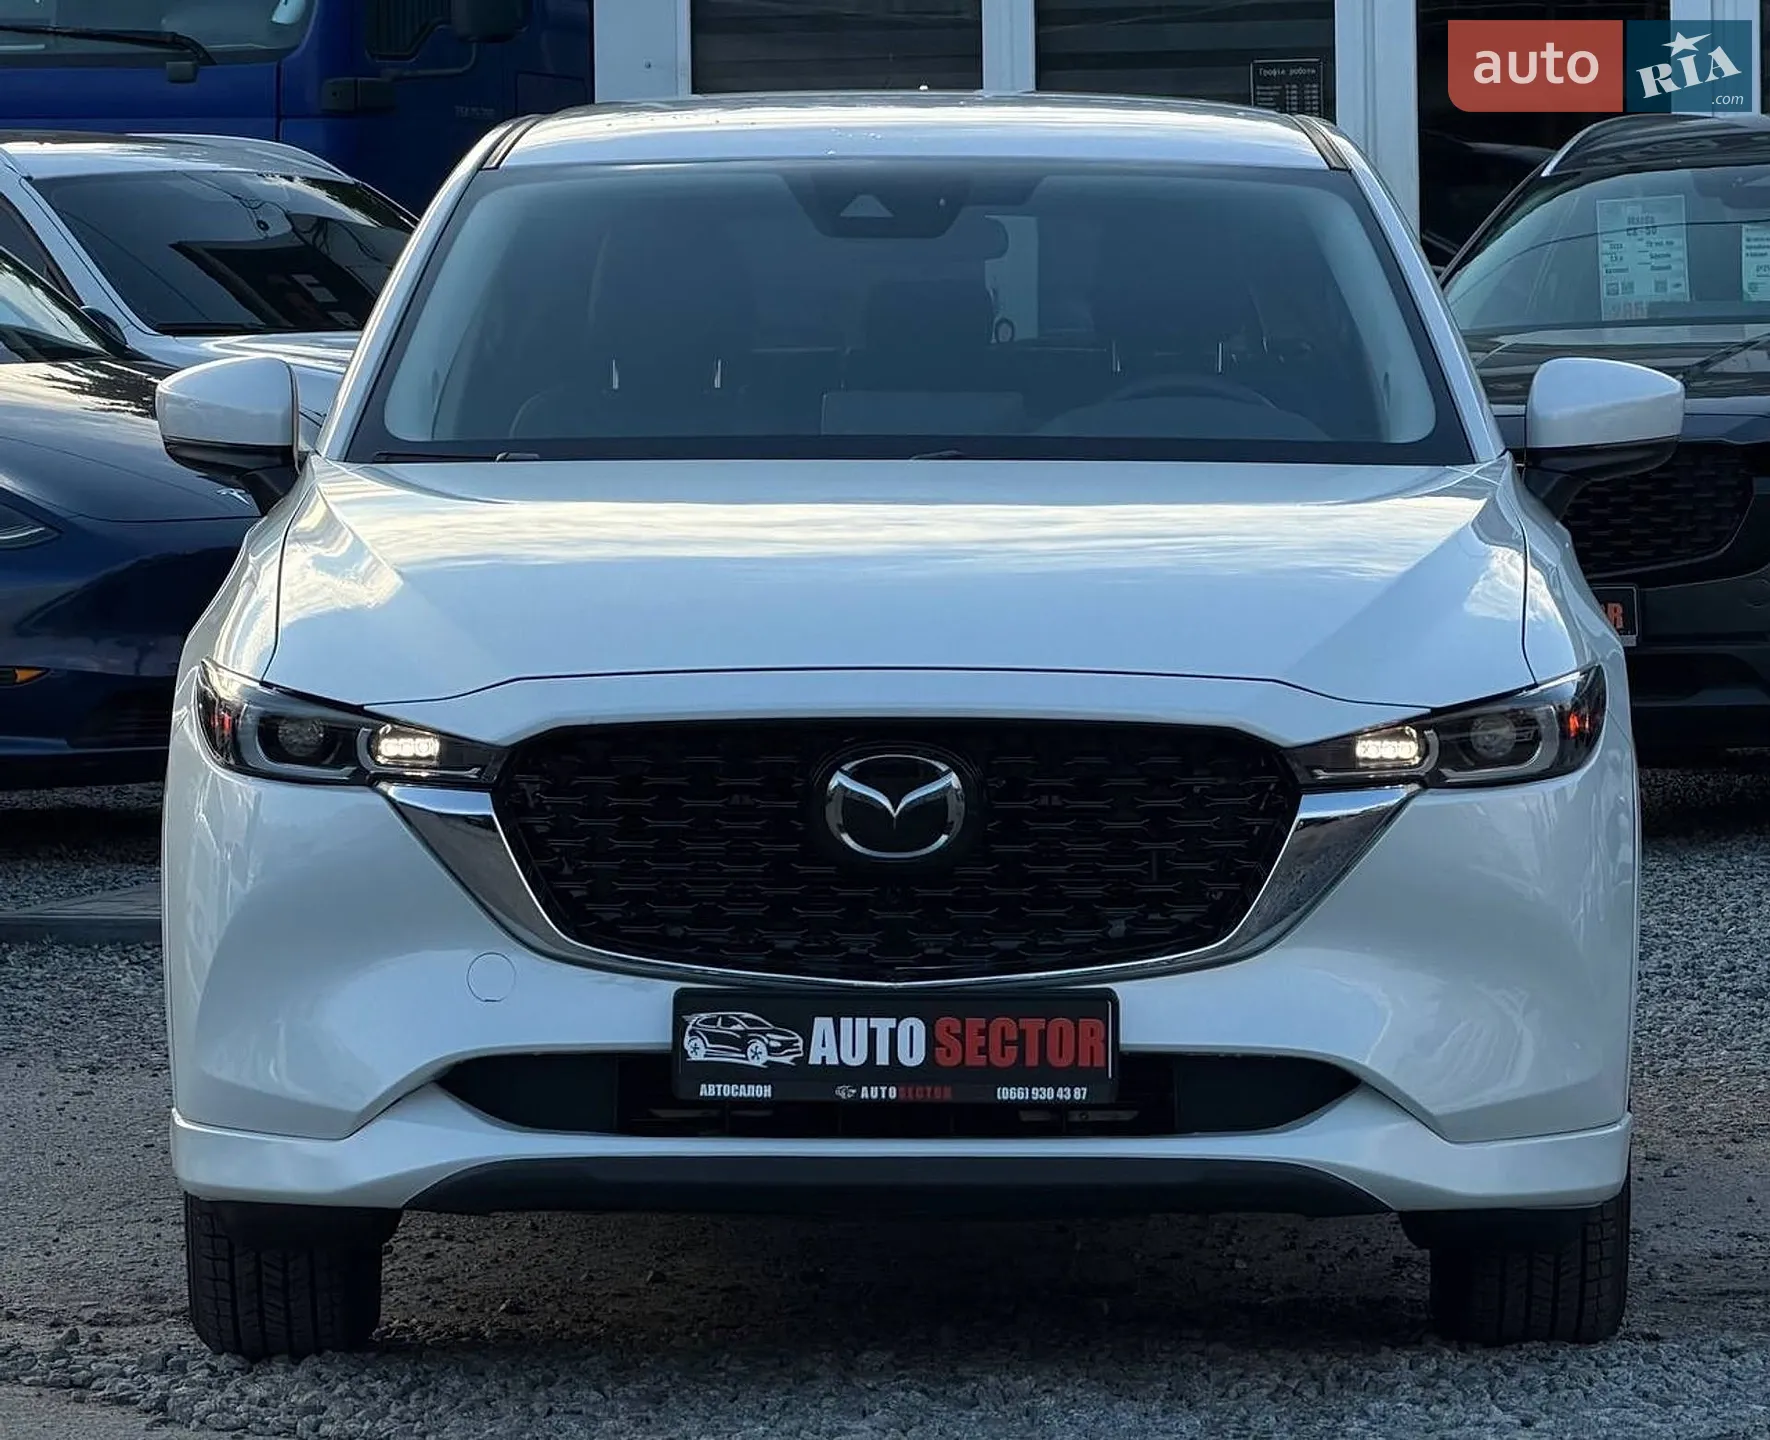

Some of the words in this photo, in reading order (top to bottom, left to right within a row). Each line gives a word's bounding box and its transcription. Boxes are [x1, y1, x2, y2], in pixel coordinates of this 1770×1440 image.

[807, 1016, 926, 1067] AUTO
[934, 1017, 1107, 1068] SECTOR
[699, 1083, 772, 1098] АВТОСАЛОН
[996, 1085, 1029, 1101] (066)
[1031, 1086, 1053, 1100] 930
[1055, 1086, 1071, 1100] 43
[1073, 1086, 1088, 1100] 87
